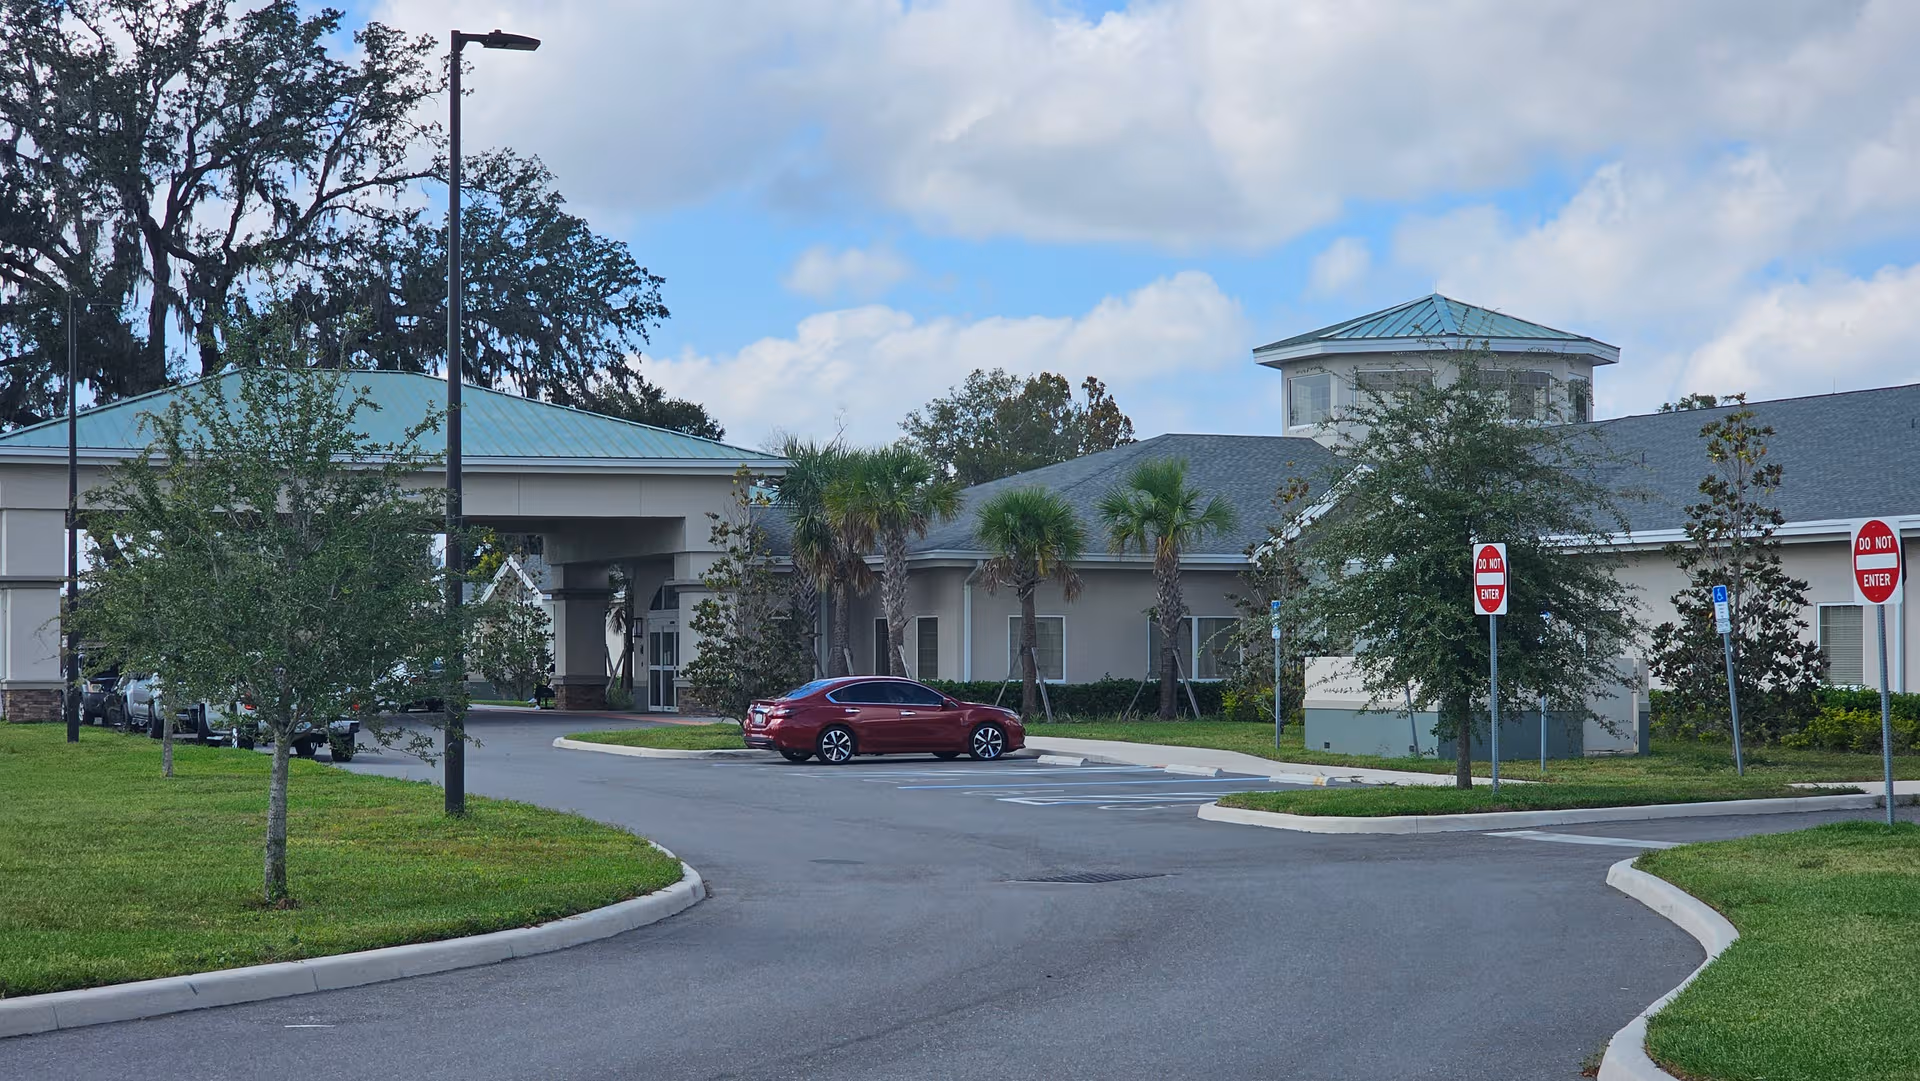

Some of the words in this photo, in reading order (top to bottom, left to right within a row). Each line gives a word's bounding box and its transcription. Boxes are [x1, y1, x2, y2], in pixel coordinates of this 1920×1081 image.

[1859, 537, 1871, 550] DO
[1875, 536, 1892, 549] NOT
[1478, 559, 1486, 570] DO
[1489, 558, 1501, 569] NOT
[1863, 573, 1891, 587] ENTER
[1481, 588, 1499, 599] ENTER
